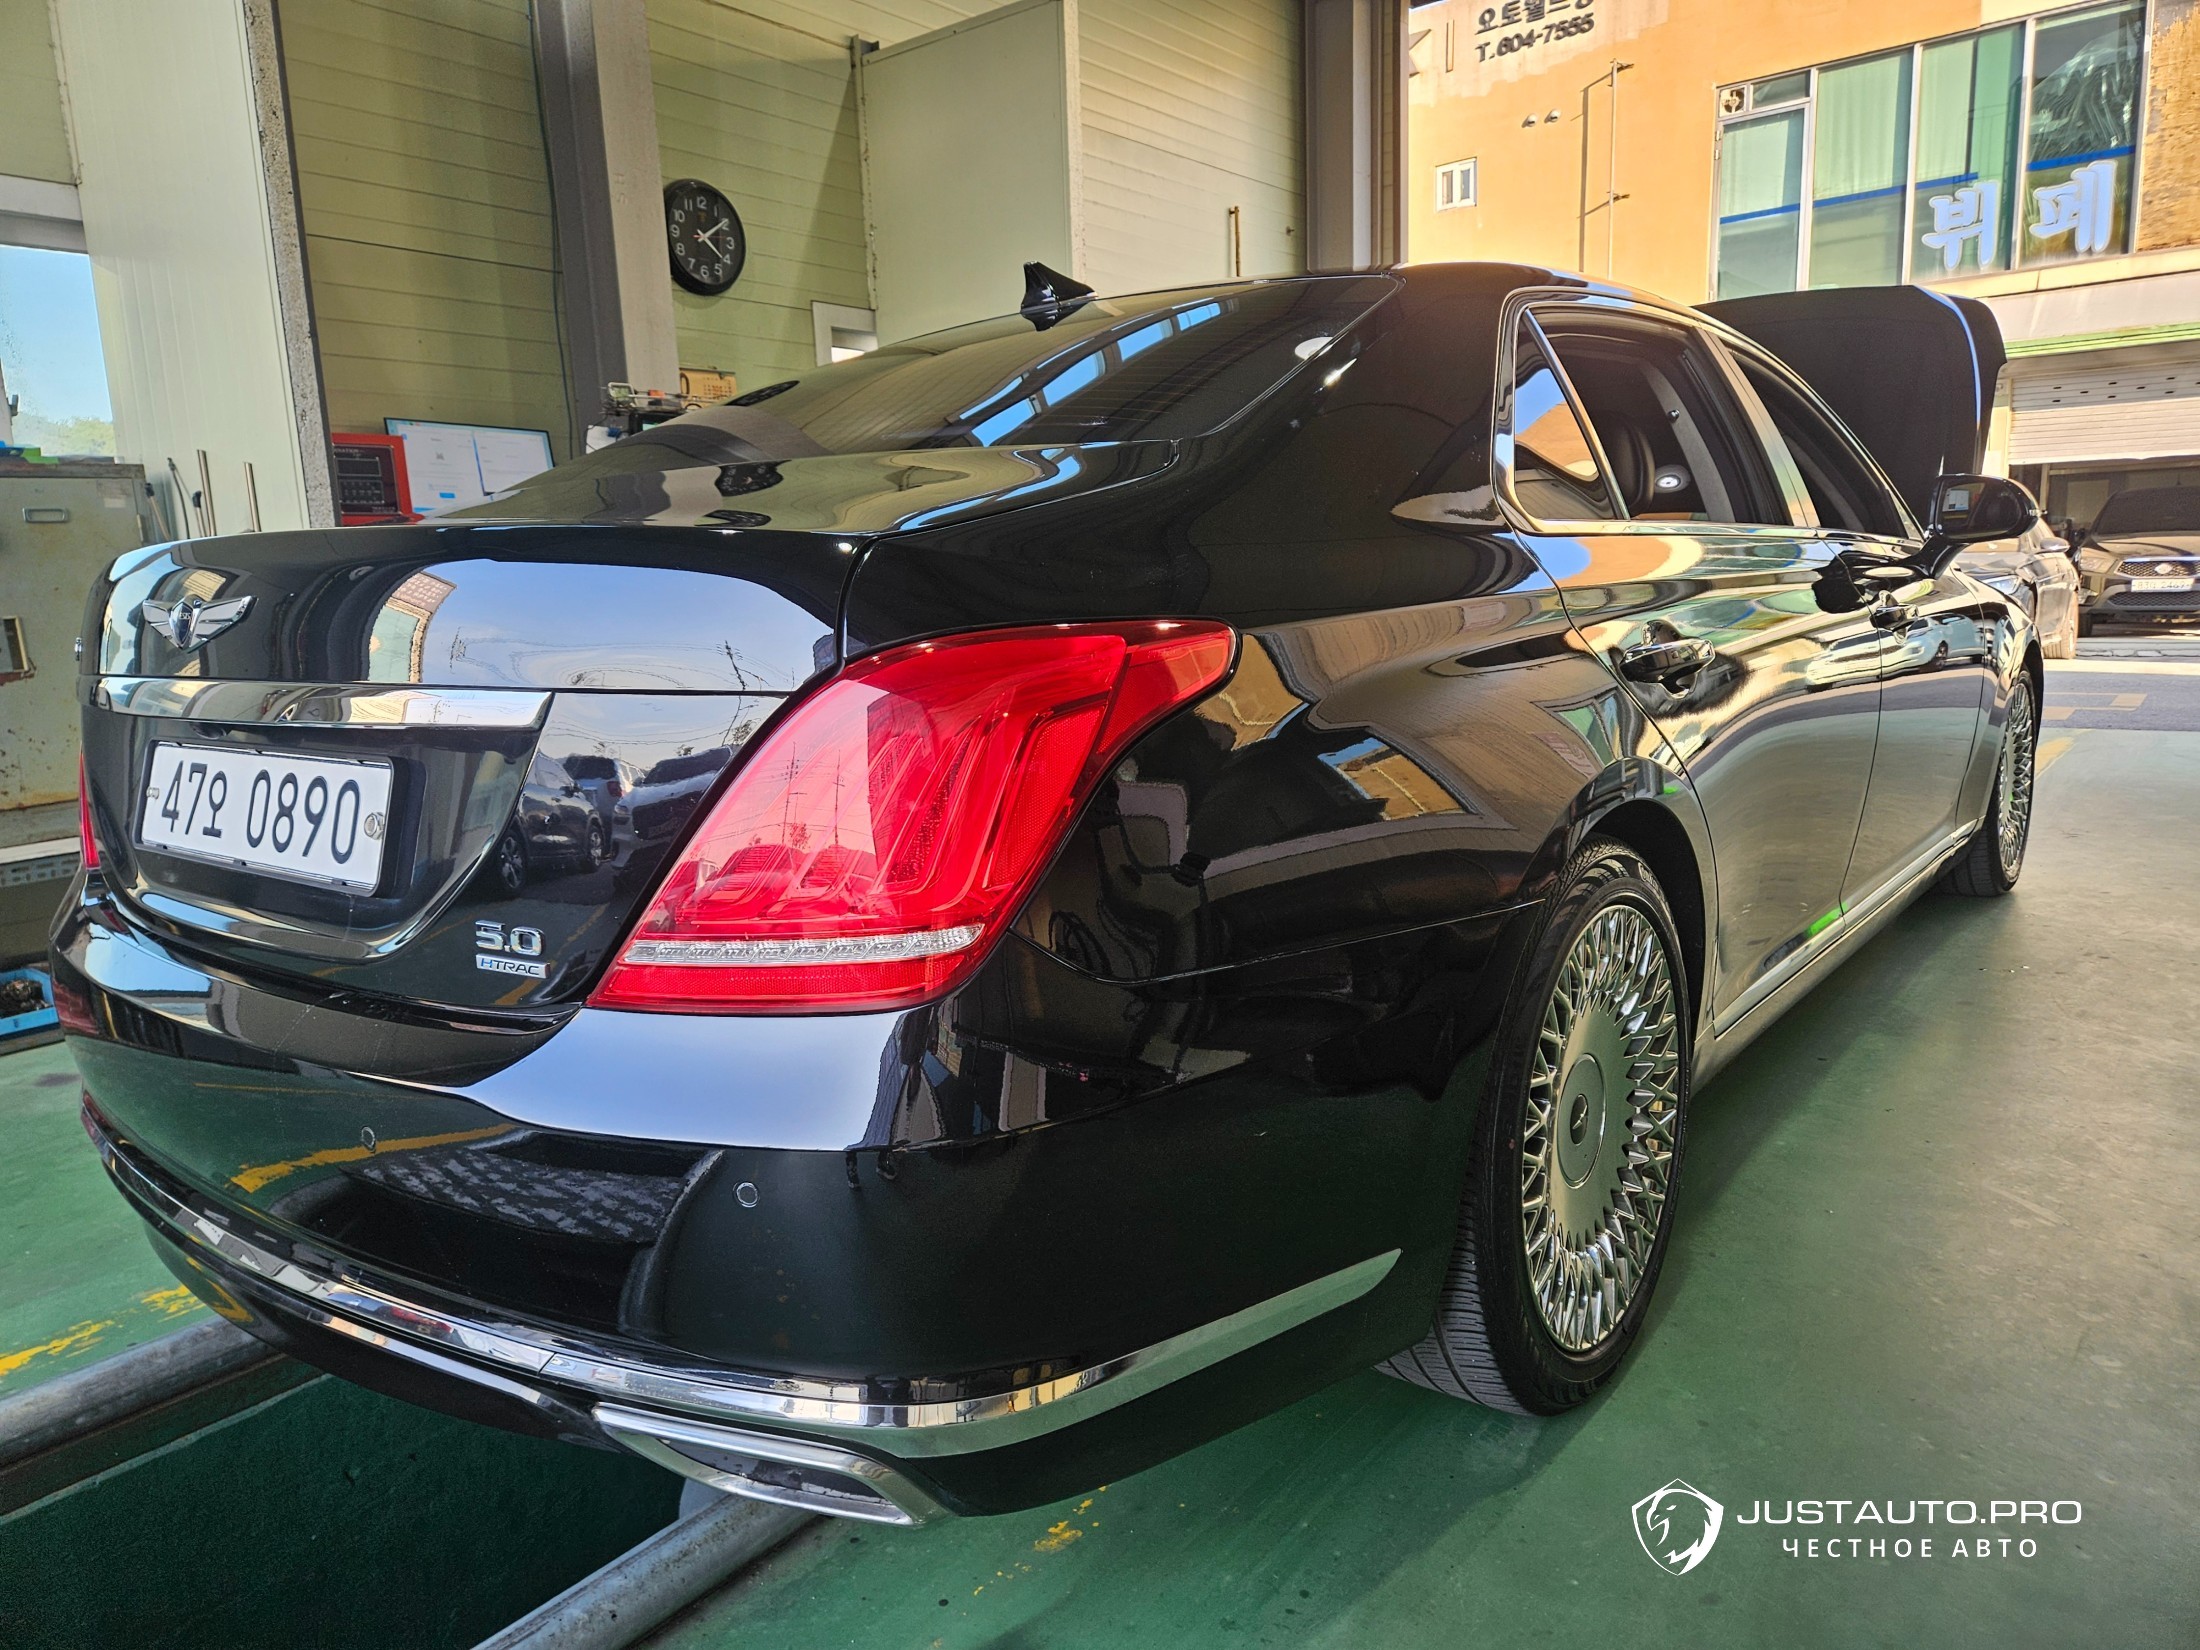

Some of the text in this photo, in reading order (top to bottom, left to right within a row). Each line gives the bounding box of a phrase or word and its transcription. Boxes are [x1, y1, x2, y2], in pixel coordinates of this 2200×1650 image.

[1475, 12, 1595, 63] T.604-7555
[684, 198, 693, 211] 11
[696, 196, 707, 209] 12
[672, 209, 685, 222] 10
[713, 204, 718, 217] 1
[670, 224, 680, 237] 9
[676, 243, 685, 256] 8
[726, 237, 735, 250] 3
[688, 257, 696, 269] 7
[723, 253, 733, 264] 4
[700, 265, 709, 279] 6
[714, 263, 722, 276] 5
[161, 760, 361, 864] 47오 0890
[475, 920, 544, 957] 5.0
[480, 958, 540, 976] HTRAC
